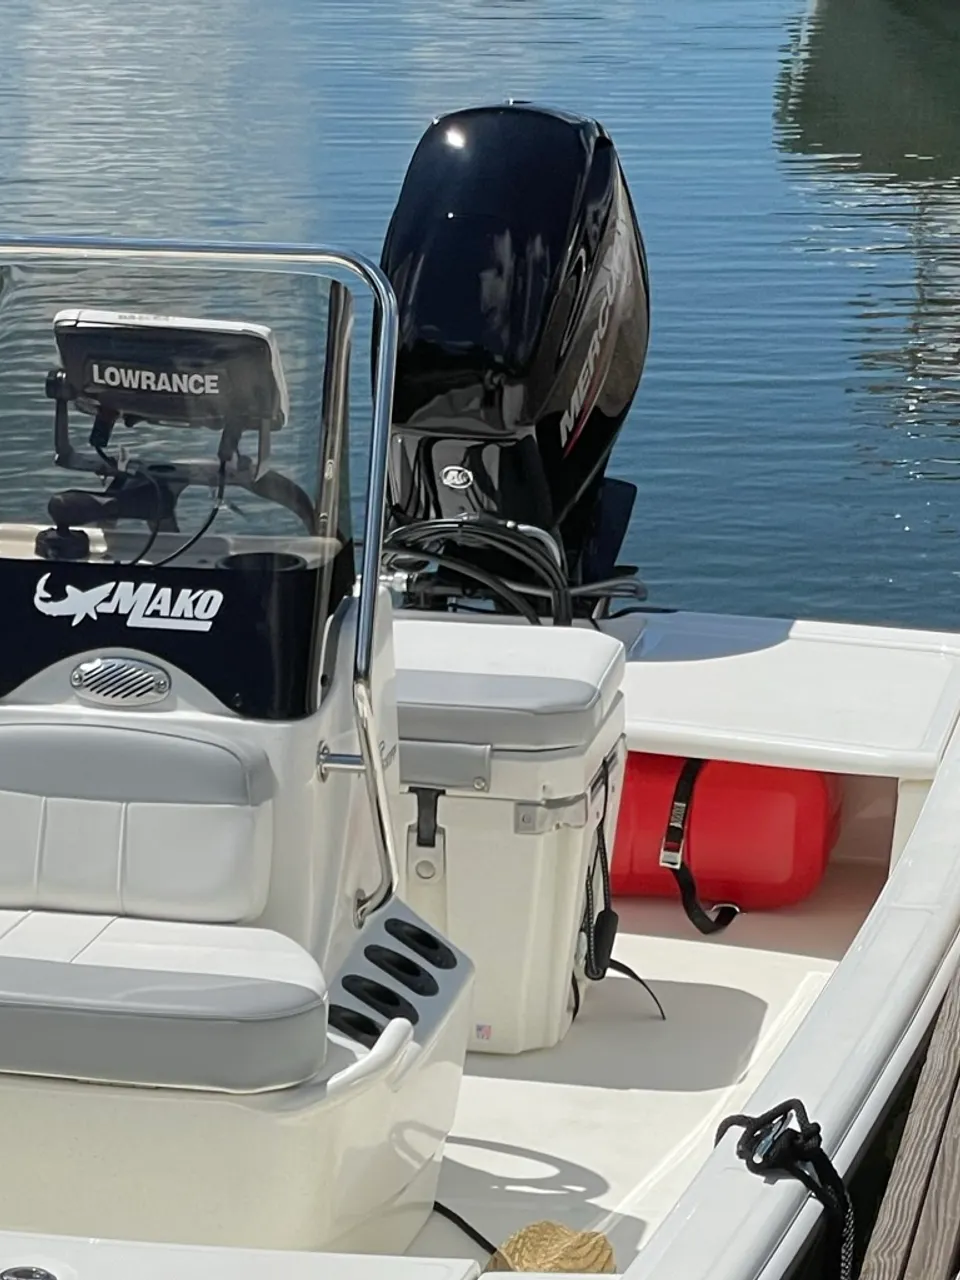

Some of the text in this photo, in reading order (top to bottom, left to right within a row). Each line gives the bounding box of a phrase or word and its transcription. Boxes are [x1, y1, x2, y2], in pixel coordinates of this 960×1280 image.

[560, 240, 625, 448] MERCU
[92, 364, 219, 394] LOWRANCE
[96, 581, 224, 632] MAKO
